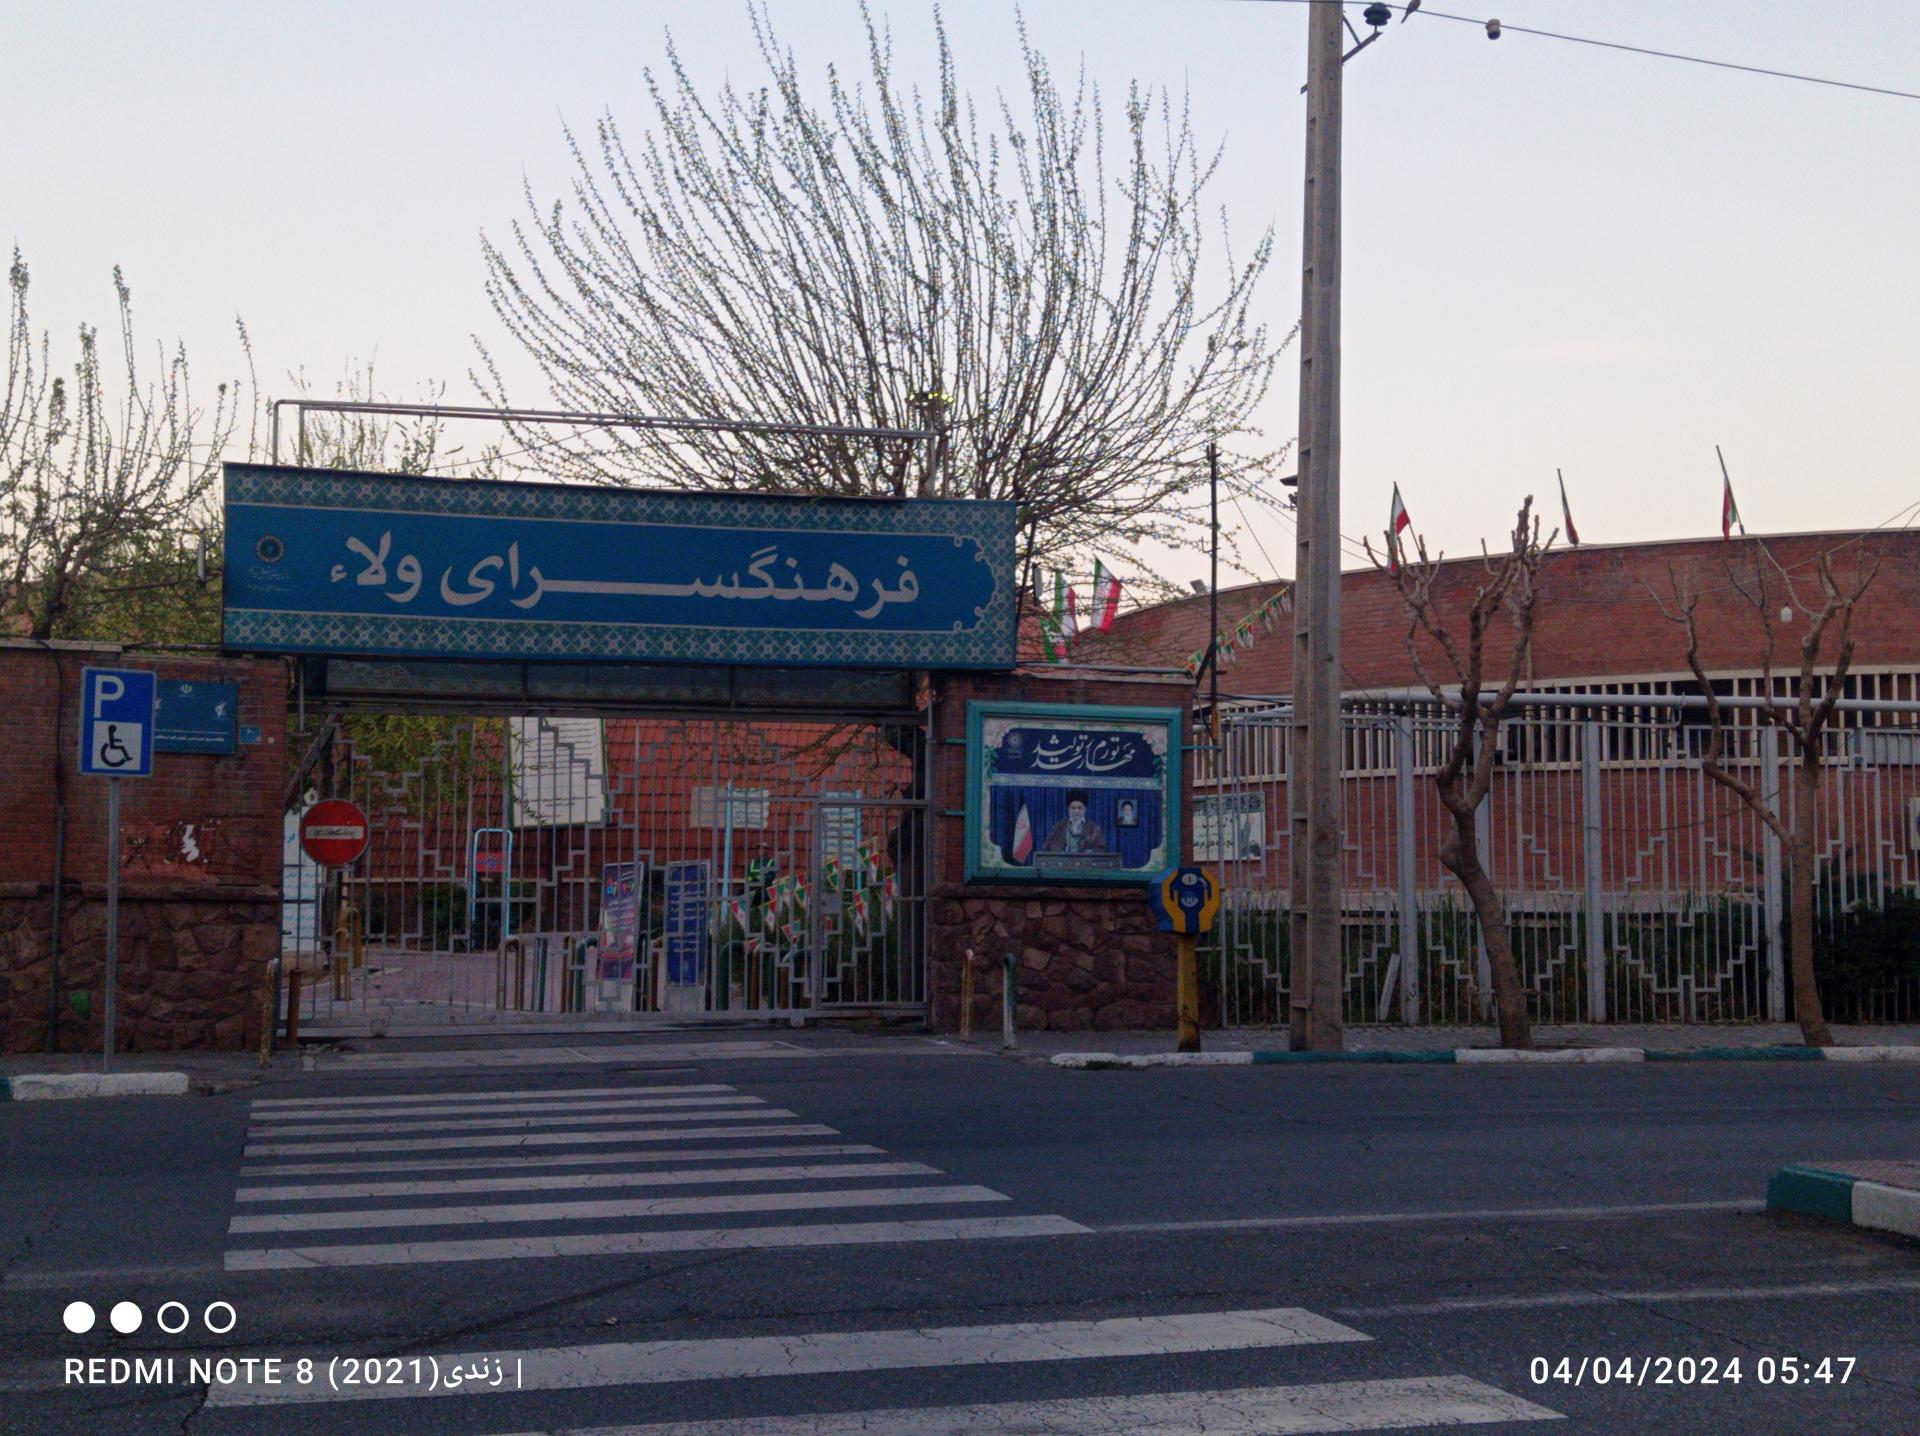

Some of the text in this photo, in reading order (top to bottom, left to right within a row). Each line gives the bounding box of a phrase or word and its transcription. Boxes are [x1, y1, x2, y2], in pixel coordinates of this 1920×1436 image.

[331, 530, 919, 619] فرهنگسرای ولاء
[94, 675, 125, 718] P
